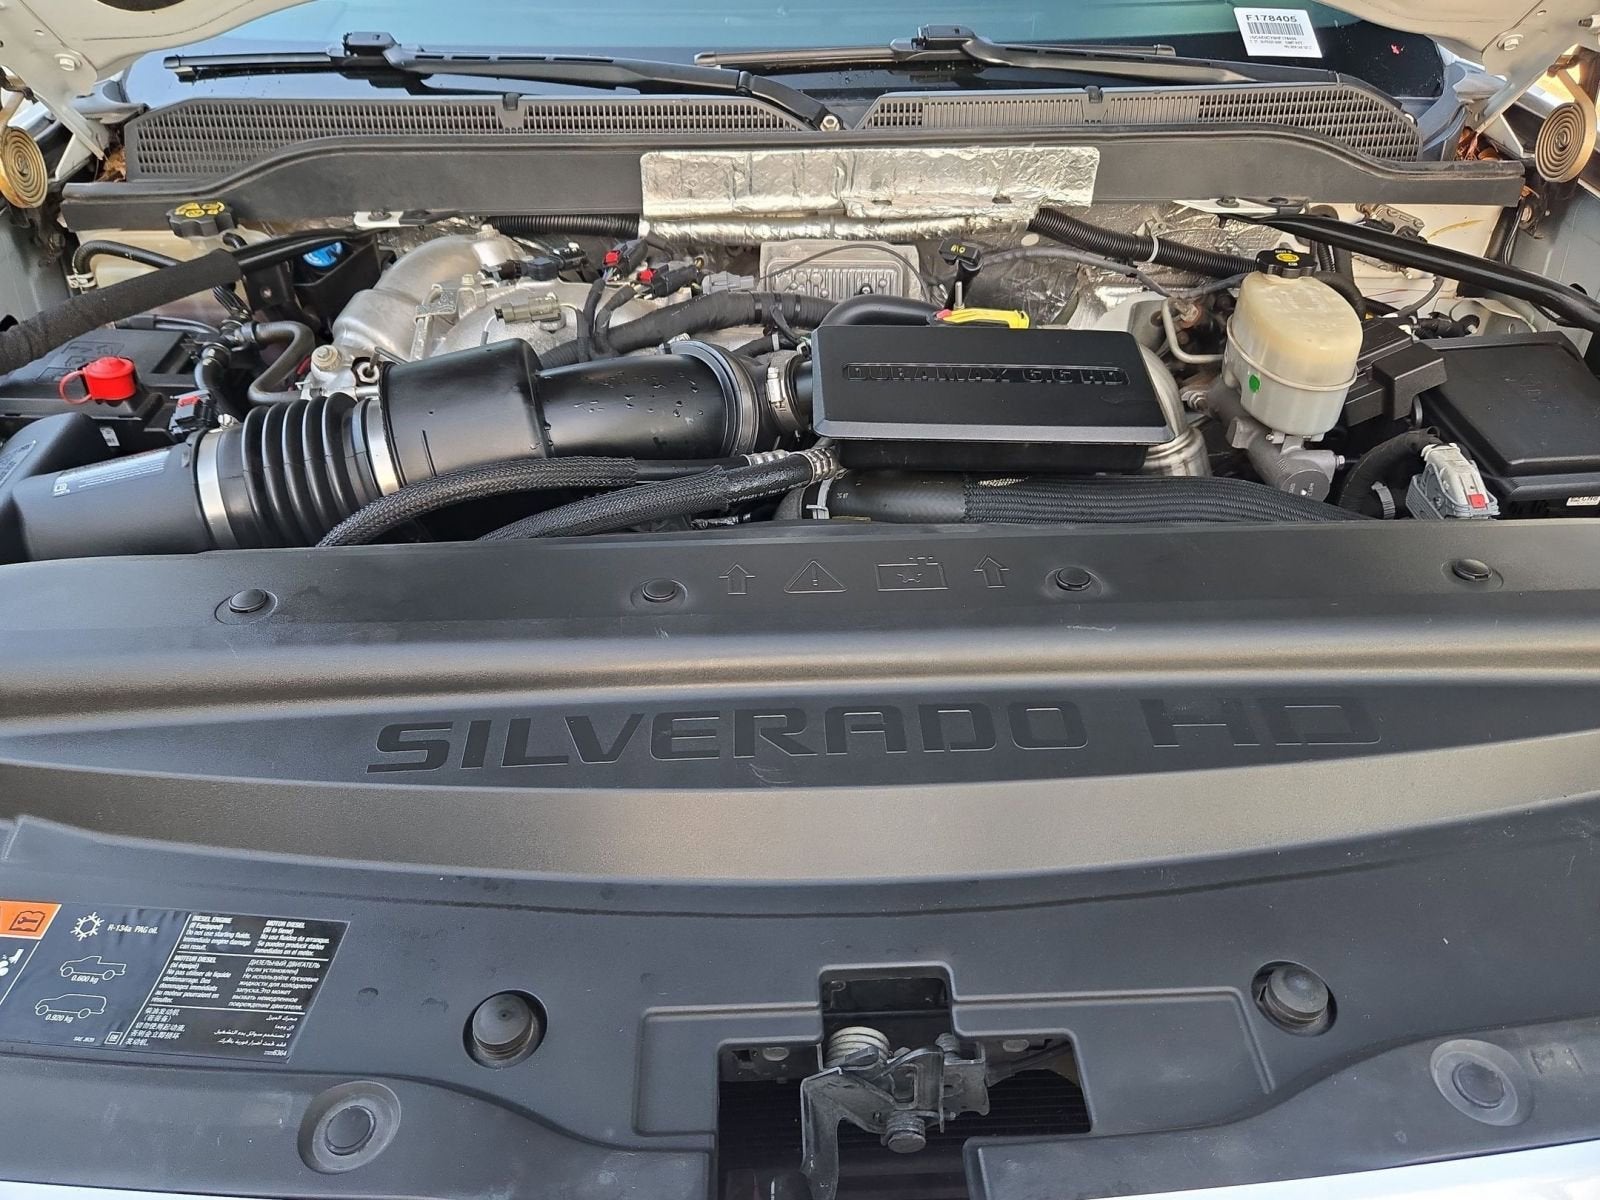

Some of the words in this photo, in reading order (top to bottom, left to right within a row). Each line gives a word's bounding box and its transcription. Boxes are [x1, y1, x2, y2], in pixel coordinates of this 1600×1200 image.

[1246, 14, 1297, 22] F178405
[848, 364, 1009, 383] DURAMAX
[366, 699, 1089, 774] SILVERADO
[1140, 698, 1382, 749] HD
[107, 923, 131, 933] R-134a
[134, 924, 148, 934] PAG
[286, 921, 306, 929] DIESEL
[214, 931, 235, 940] starting
[278, 934, 298, 942] fluidos
[211, 938, 229, 946] engine
[229, 939, 251, 947] damage
[89, 975, 99, 984] kg
[212, 971, 232, 979] liquide
[159, 983, 190, 991] dommages
[63, 1014, 74, 1024] kg
